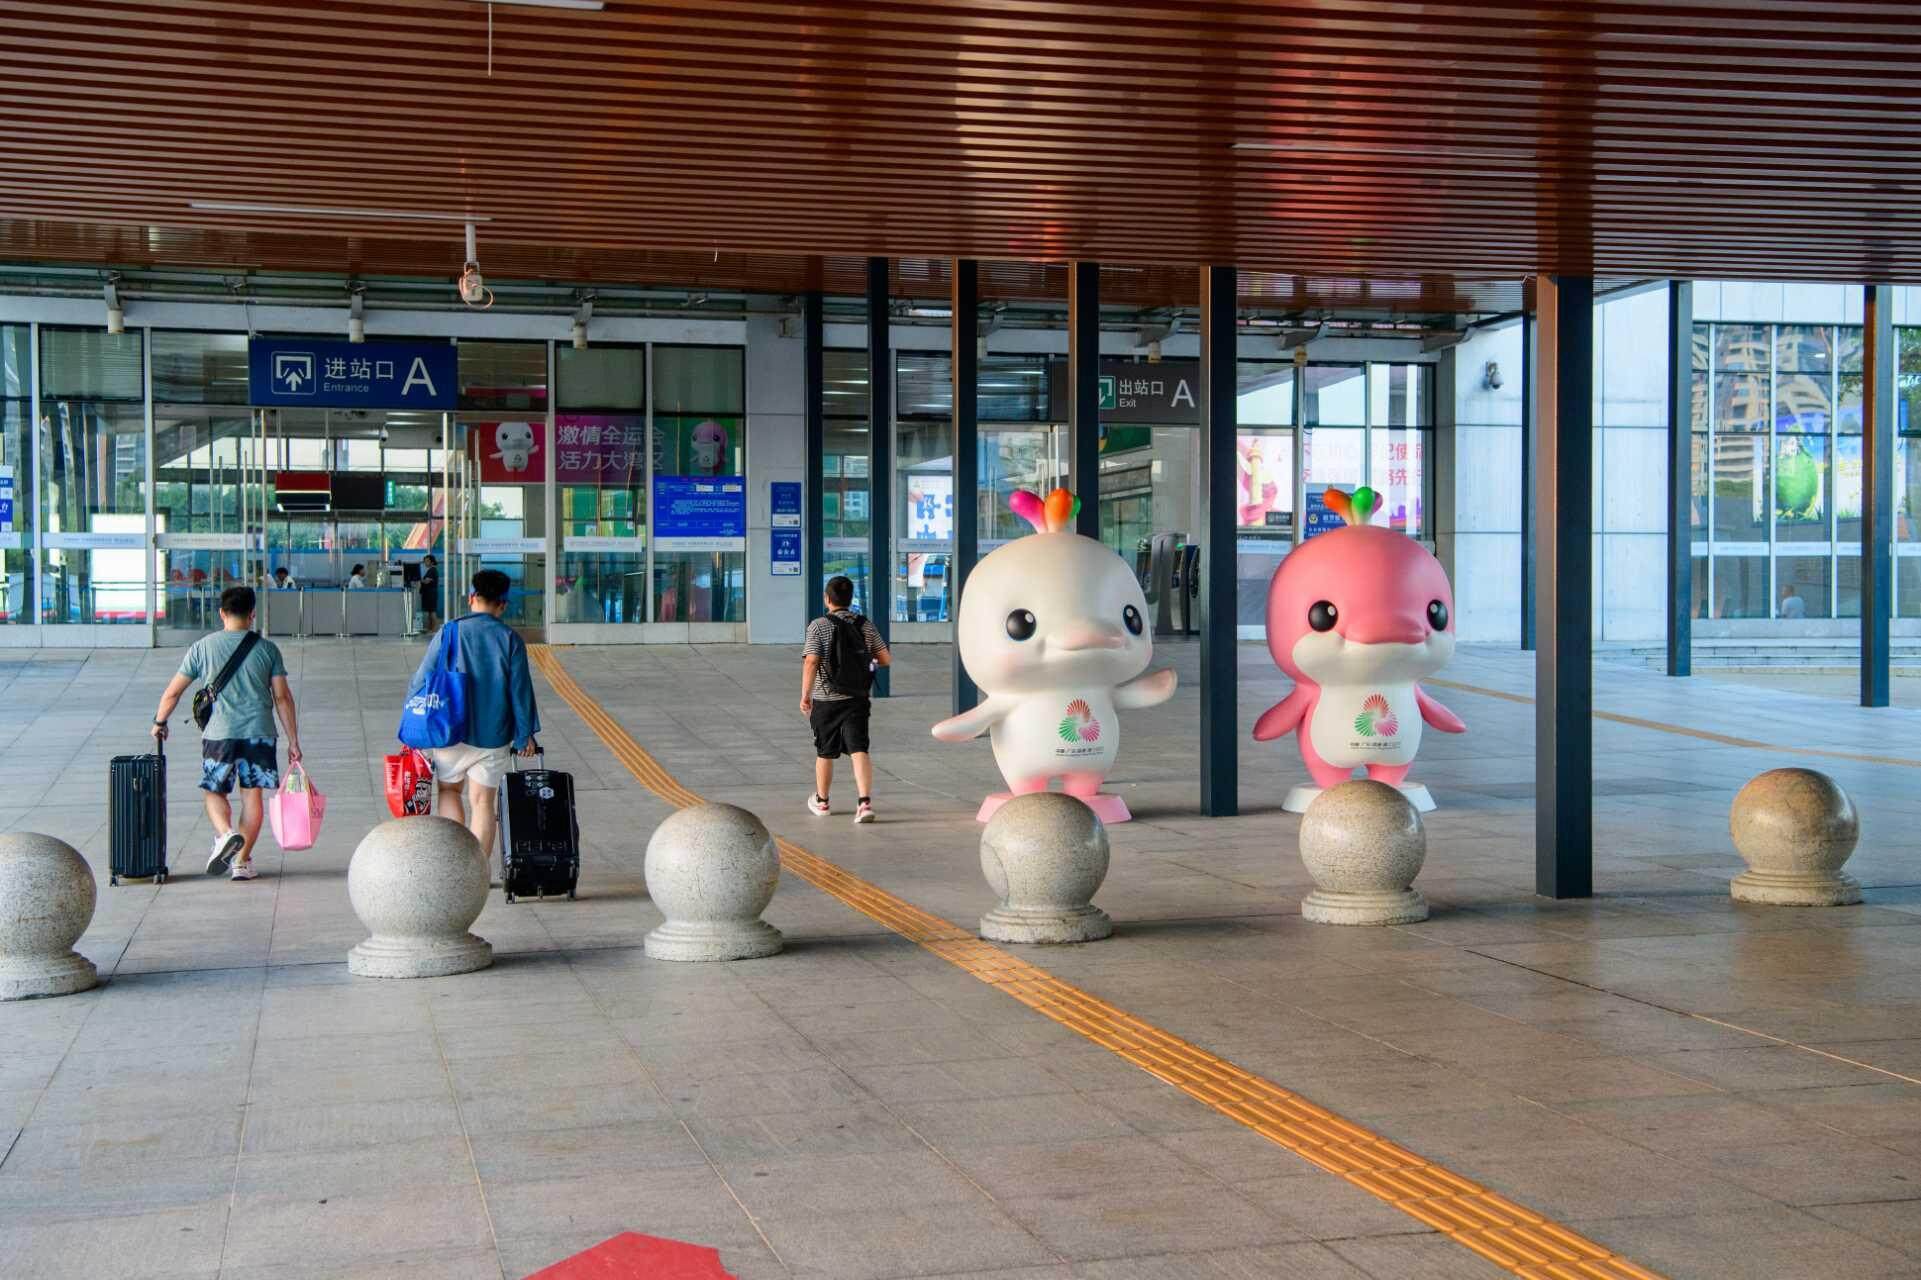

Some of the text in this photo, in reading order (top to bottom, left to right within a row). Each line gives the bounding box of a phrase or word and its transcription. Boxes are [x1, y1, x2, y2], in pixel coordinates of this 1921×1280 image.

[324, 357, 437, 396] 进站口 A
[323, 382, 369, 393] Entrance
[1119, 378, 1195, 408] 出站口 A
[1119, 398, 1137, 408] Exit
[558, 425, 665, 446] 激情全运会
[559, 450, 664, 470] 活力大湾区
